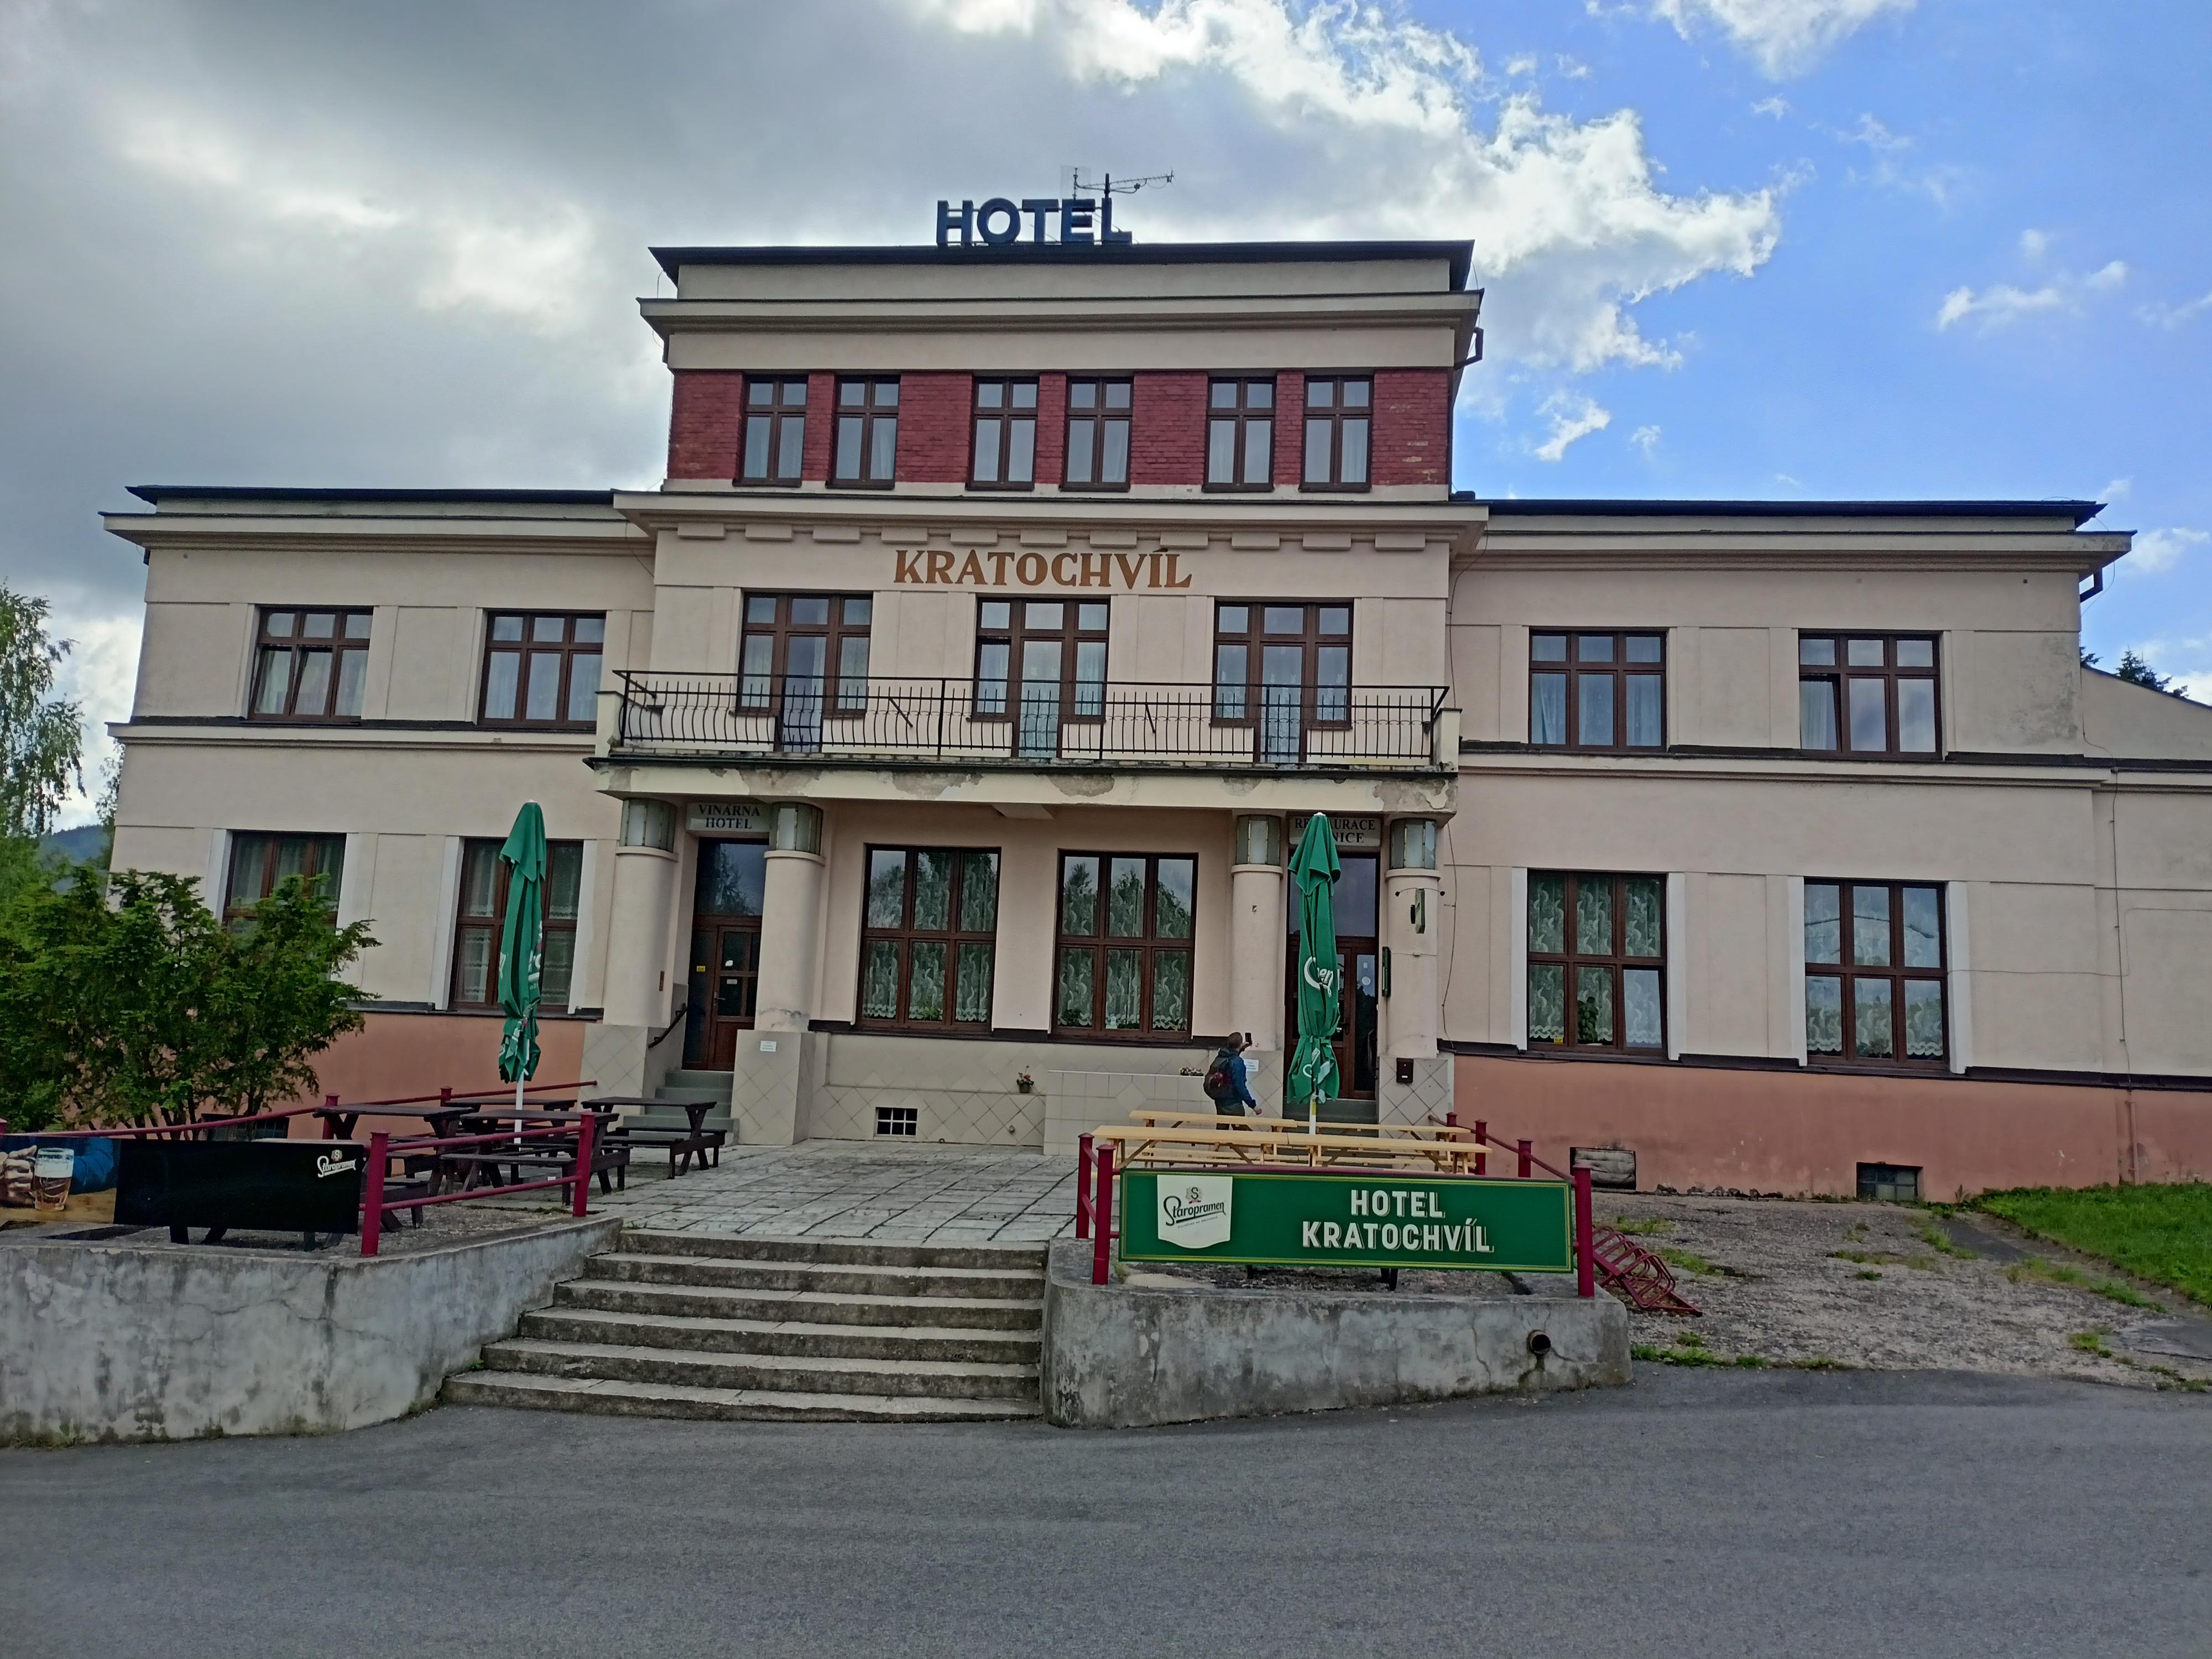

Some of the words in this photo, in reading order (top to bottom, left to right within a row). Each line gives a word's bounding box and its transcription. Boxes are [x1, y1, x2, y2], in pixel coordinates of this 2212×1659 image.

[936, 197, 1133, 248] HOTEL
[893, 547, 1192, 589] KRATOCHVÍL
[699, 804, 760, 816] VINÁRNA
[706, 817, 753, 829] HOTEL
[1295, 818, 1375, 830] REURACE
[1333, 832, 1364, 843] NICE
[1163, 1195, 1227, 1226] Staropramen
[1351, 1190, 1446, 1218] HOTEL
[1302, 1218, 1494, 1253] KRATOCHVÍL
